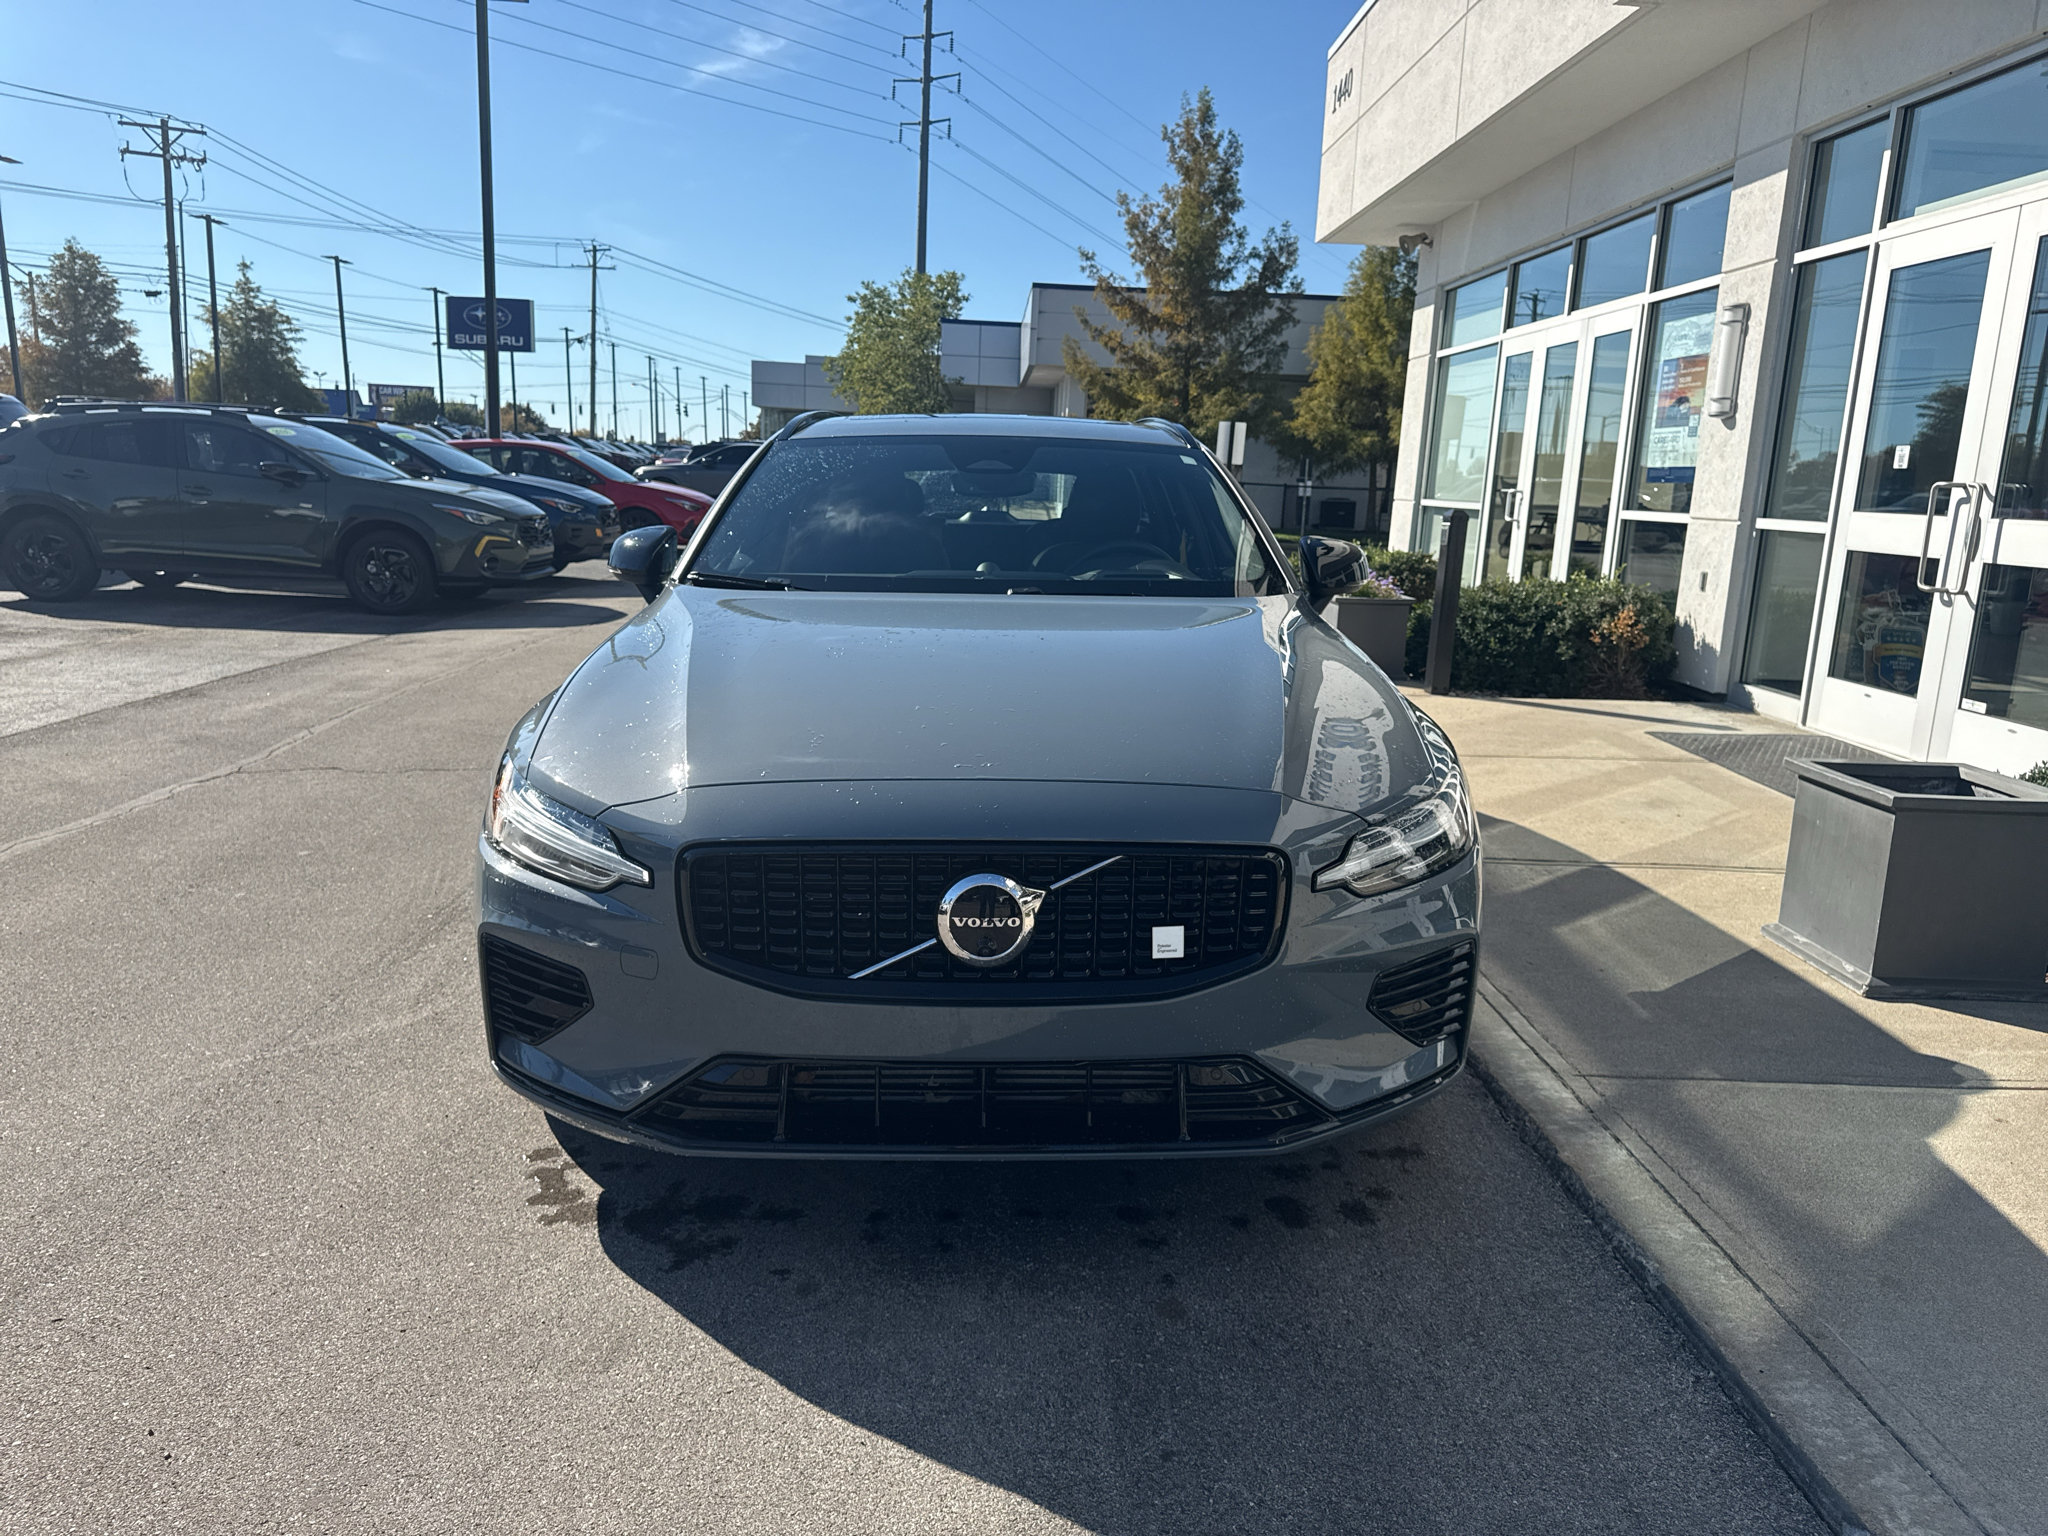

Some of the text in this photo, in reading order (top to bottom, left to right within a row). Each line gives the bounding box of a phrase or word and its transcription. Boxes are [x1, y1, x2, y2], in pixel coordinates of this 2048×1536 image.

[1332, 67, 1354, 114] 1440
[454, 333, 524, 347] SUBRU
[951, 916, 1021, 928] VOLVO
